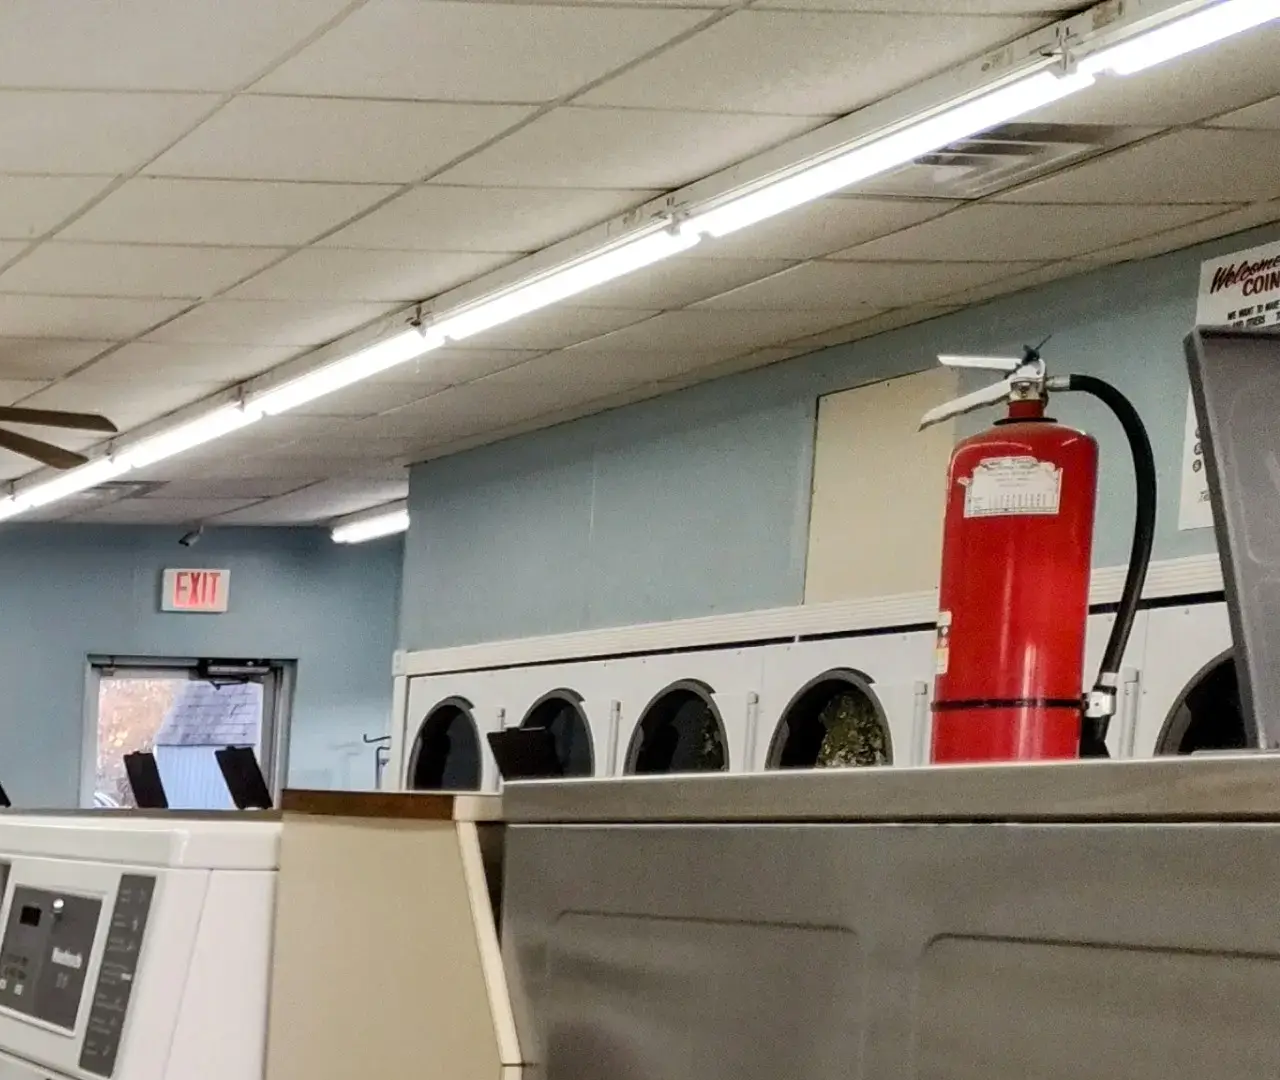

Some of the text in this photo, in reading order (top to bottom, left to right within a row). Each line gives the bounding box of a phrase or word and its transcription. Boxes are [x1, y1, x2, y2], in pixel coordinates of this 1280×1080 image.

[1210, 254, 1280, 295] Welcome
[1242, 270, 1280, 297] COIN
[175, 571, 221, 606] EXIT
